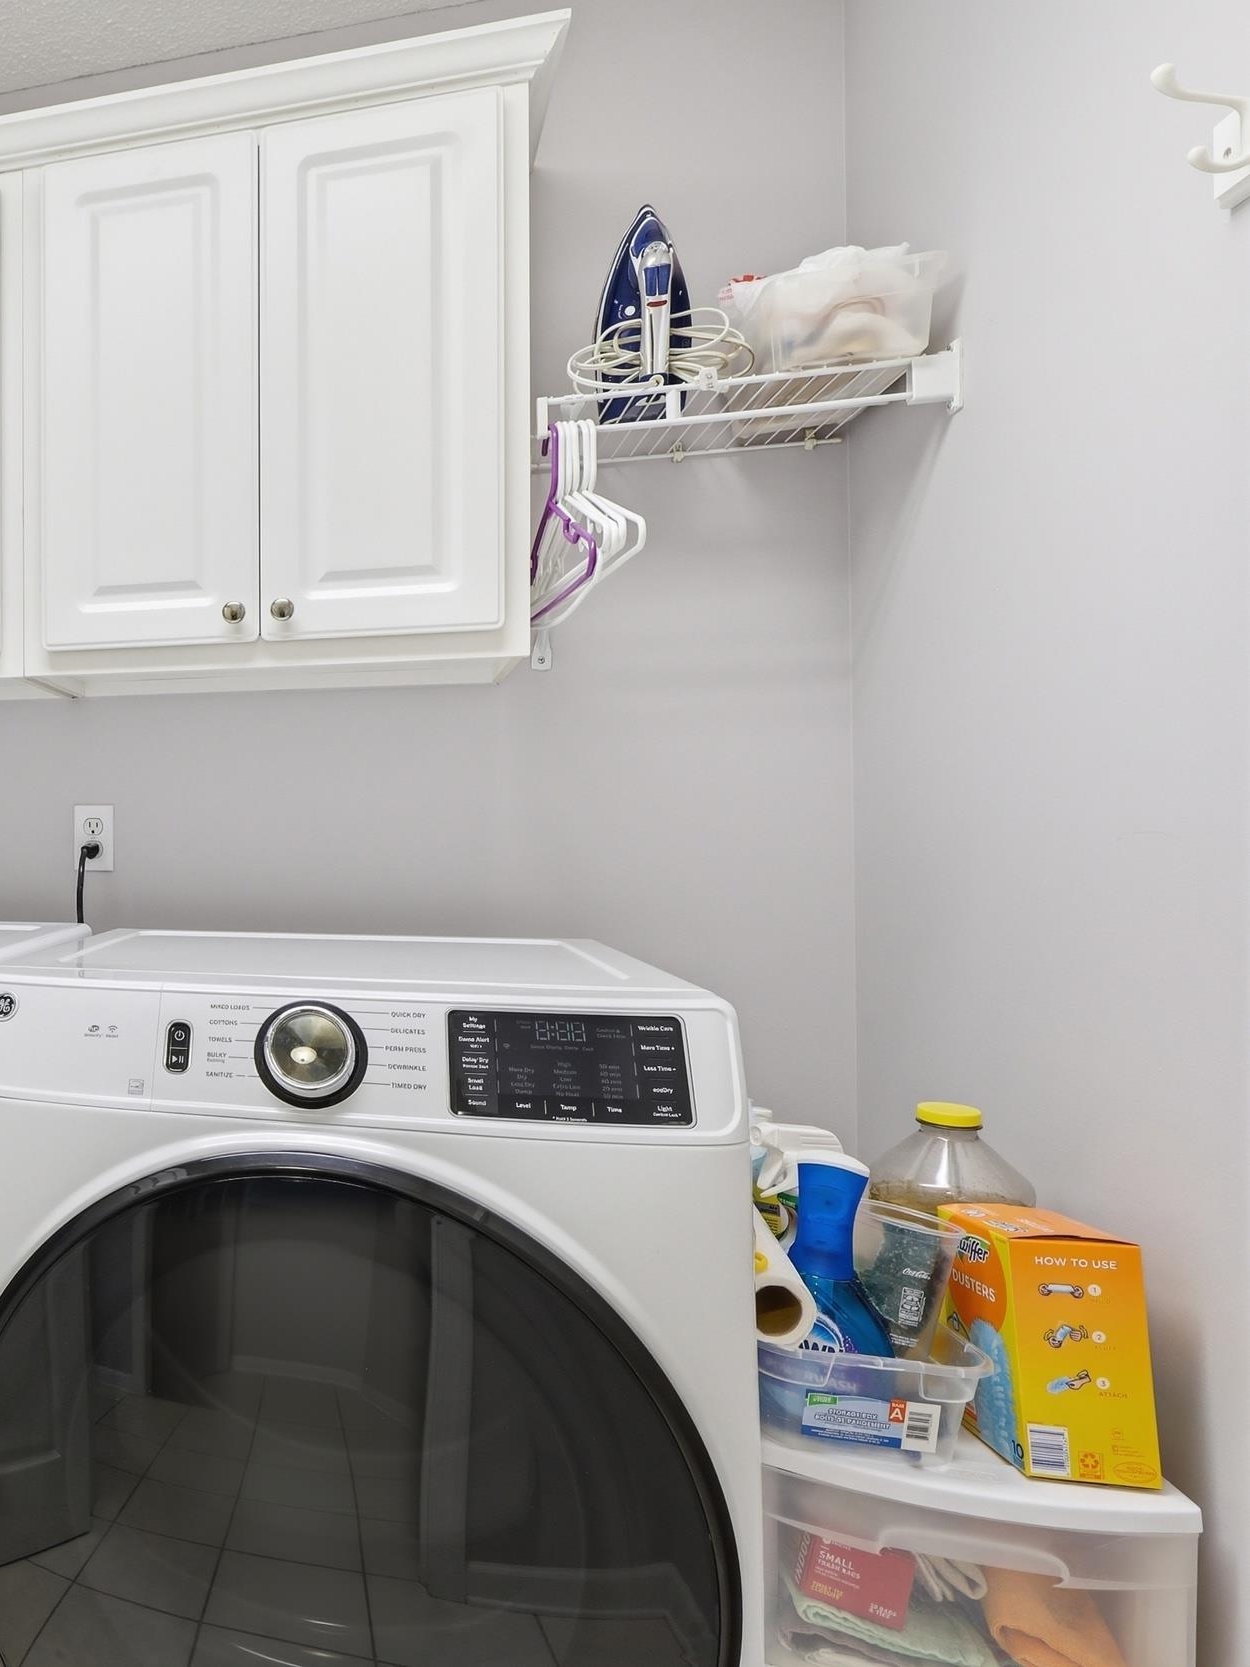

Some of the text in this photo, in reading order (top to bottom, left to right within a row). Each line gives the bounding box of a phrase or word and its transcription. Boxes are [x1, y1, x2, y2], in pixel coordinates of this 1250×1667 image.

[958, 1236, 989, 1262] wiffer
[1035, 1256, 1118, 1269] HOW TO USE
[952, 1268, 996, 1303] DUSTERS
[828, 1408, 860, 1418] STORAGE
[890, 1408, 903, 1420] A
[1011, 1439, 1025, 1460] 10
[794, 1533, 810, 1586] INDOO
[817, 1559, 841, 1571] TRASH
[842, 1568, 861, 1580] BAGS
[819, 1550, 855, 1571] SMALL
